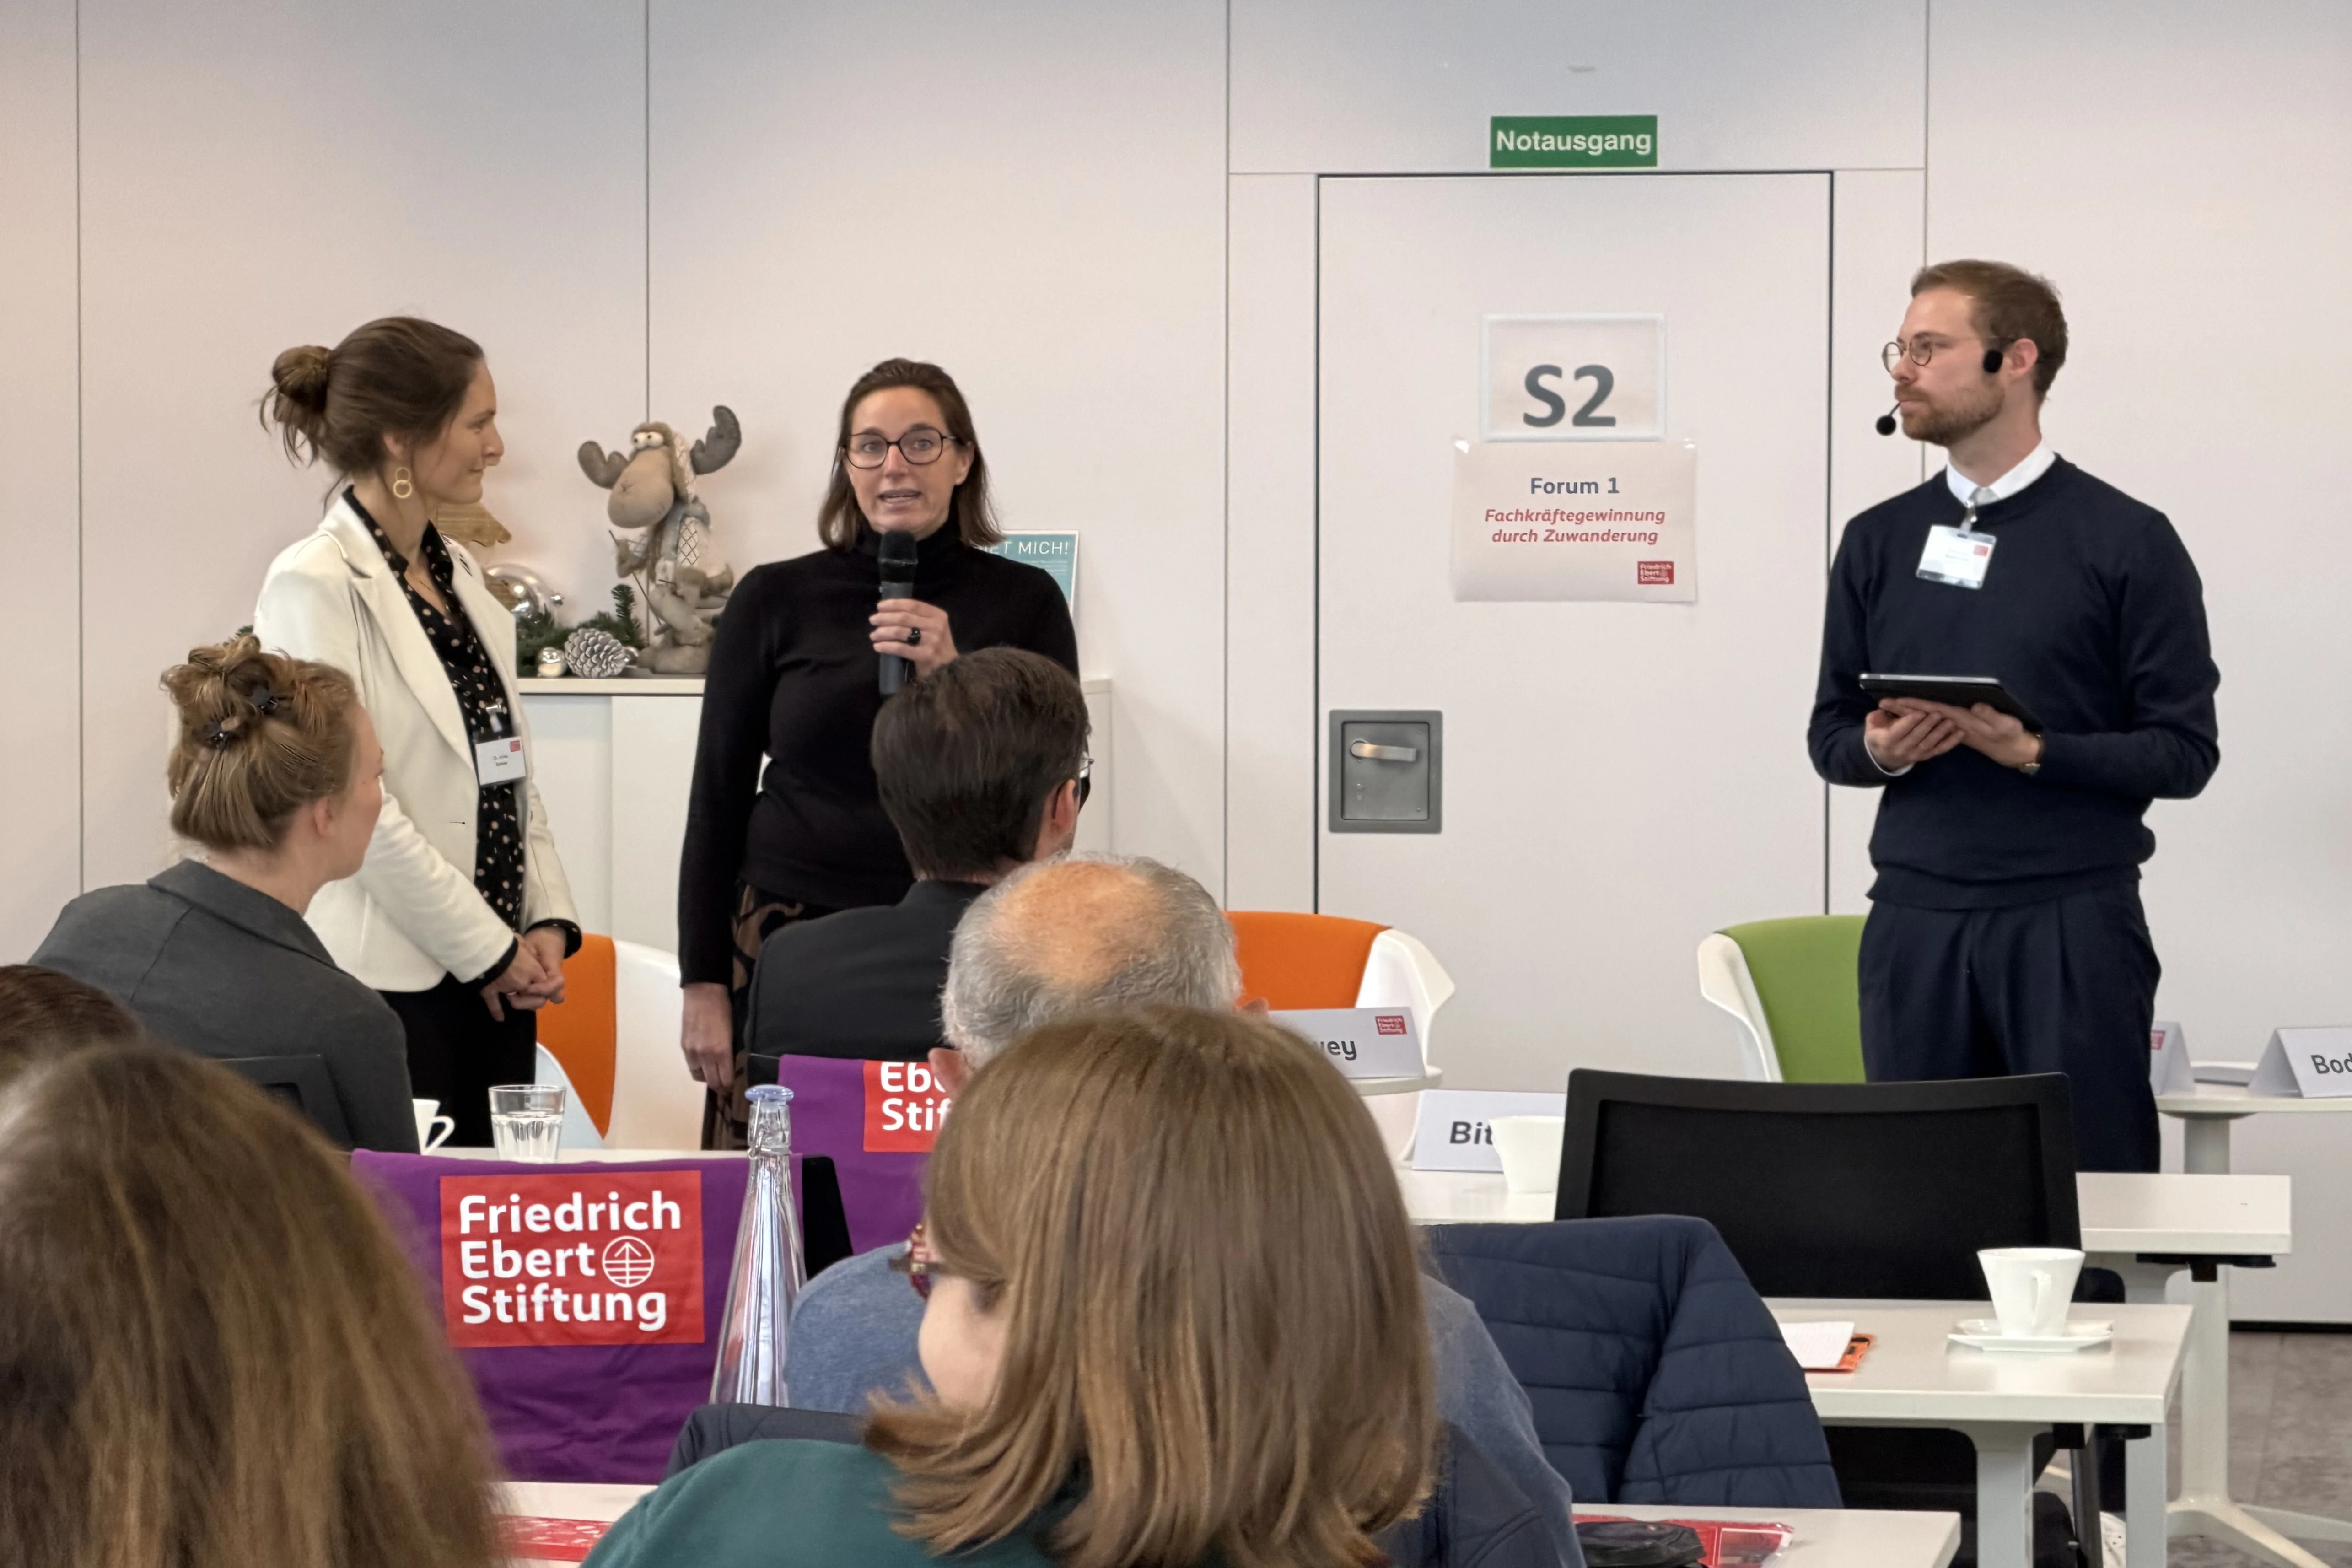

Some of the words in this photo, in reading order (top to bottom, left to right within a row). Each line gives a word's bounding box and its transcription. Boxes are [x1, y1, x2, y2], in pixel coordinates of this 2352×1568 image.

[1496, 129, 1652, 156] Notausgang
[1523, 364, 1616, 428] S2
[1530, 477, 1599, 494] Forum
[1607, 477, 1620, 494] 1
[1485, 508, 1665, 525] Fachkräftegewinnung
[1018, 541, 1069, 555] MICH!
[1491, 529, 1538, 543] durch
[1543, 529, 1658, 545] Zuwanderung
[460, 1190, 681, 1234] Friedrich
[460, 1239, 596, 1279] Ebert
[462, 1282, 667, 1331] Stiftung
